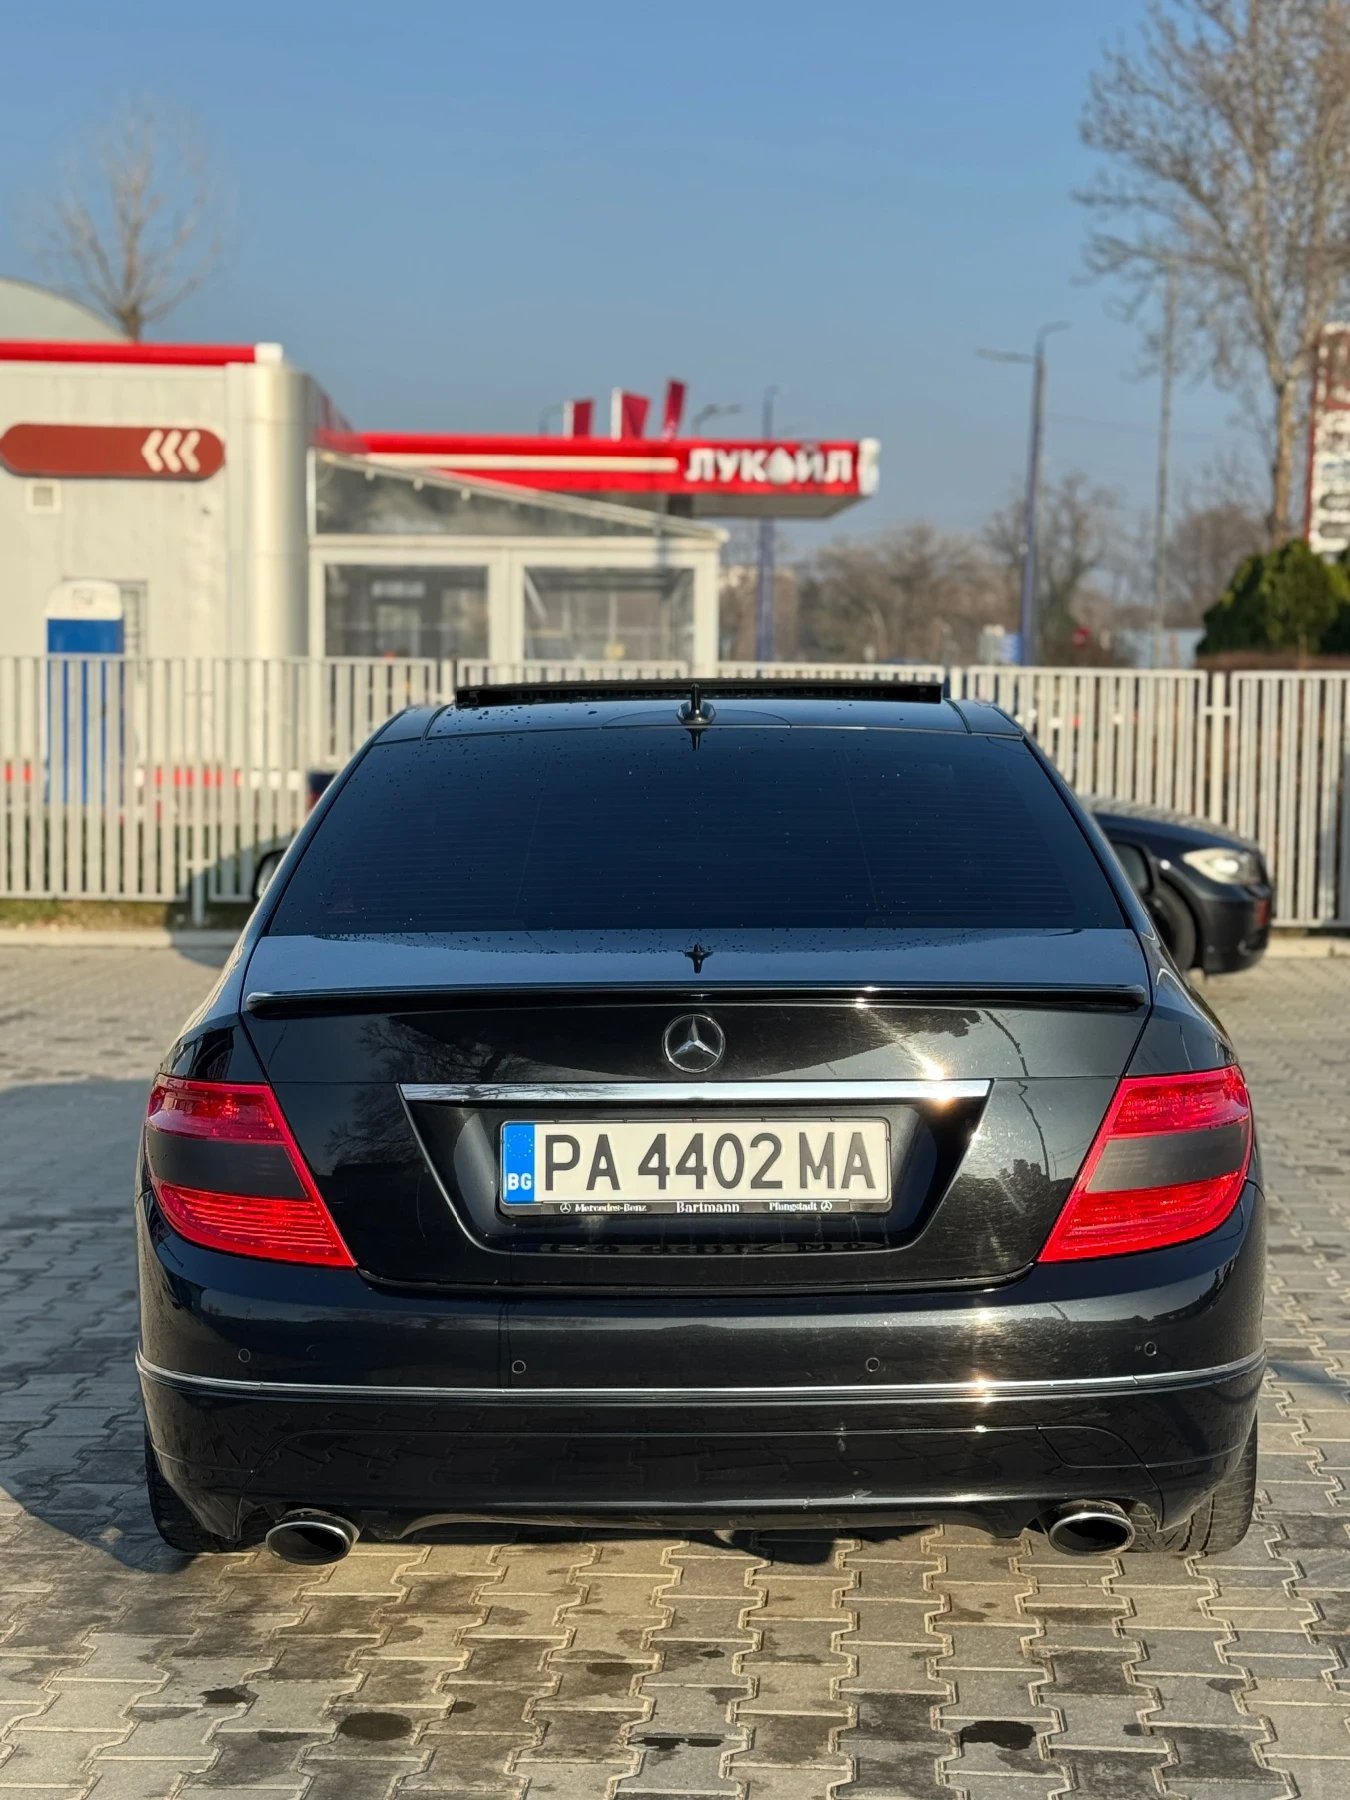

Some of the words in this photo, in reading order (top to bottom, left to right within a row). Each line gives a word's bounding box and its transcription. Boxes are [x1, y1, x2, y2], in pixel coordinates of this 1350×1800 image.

[545, 1134, 620, 1191] PA
[638, 1133, 783, 1190] 4402
[799, 1132, 876, 1189] MA
[507, 1172, 532, 1191] BG
[574, 1203, 647, 1213] Mercedes-Benz
[676, 1201, 740, 1214] Bartmann
[769, 1202, 817, 1212] Pfungstadt
